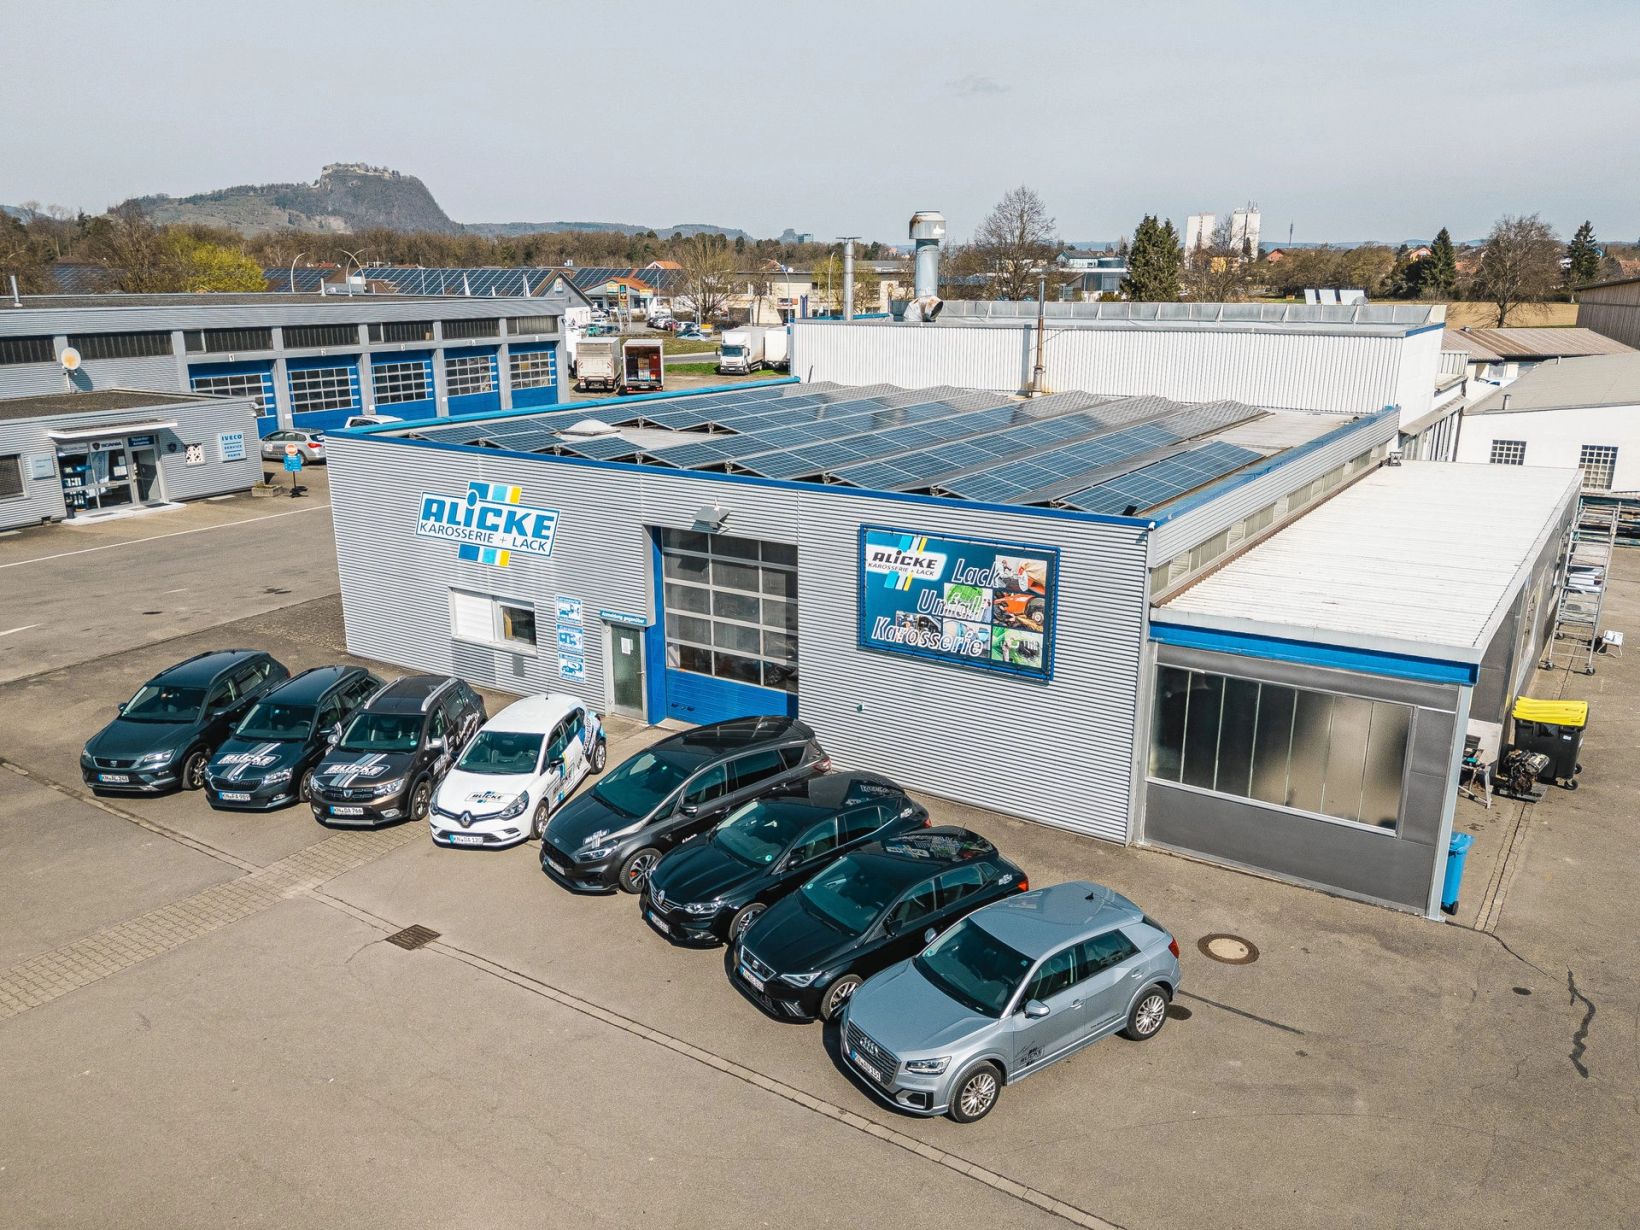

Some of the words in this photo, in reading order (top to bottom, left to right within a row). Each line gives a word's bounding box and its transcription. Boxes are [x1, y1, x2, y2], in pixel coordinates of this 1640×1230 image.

[420, 522, 494, 544] KAROSSERIE
[512, 538, 547, 552] LACK
[867, 562, 908, 572] KAROSSERIE
[916, 569, 934, 577] LACK
[951, 559, 1002, 588] Lack
[916, 589, 987, 621] Unfall
[871, 616, 984, 657] Karosserie
